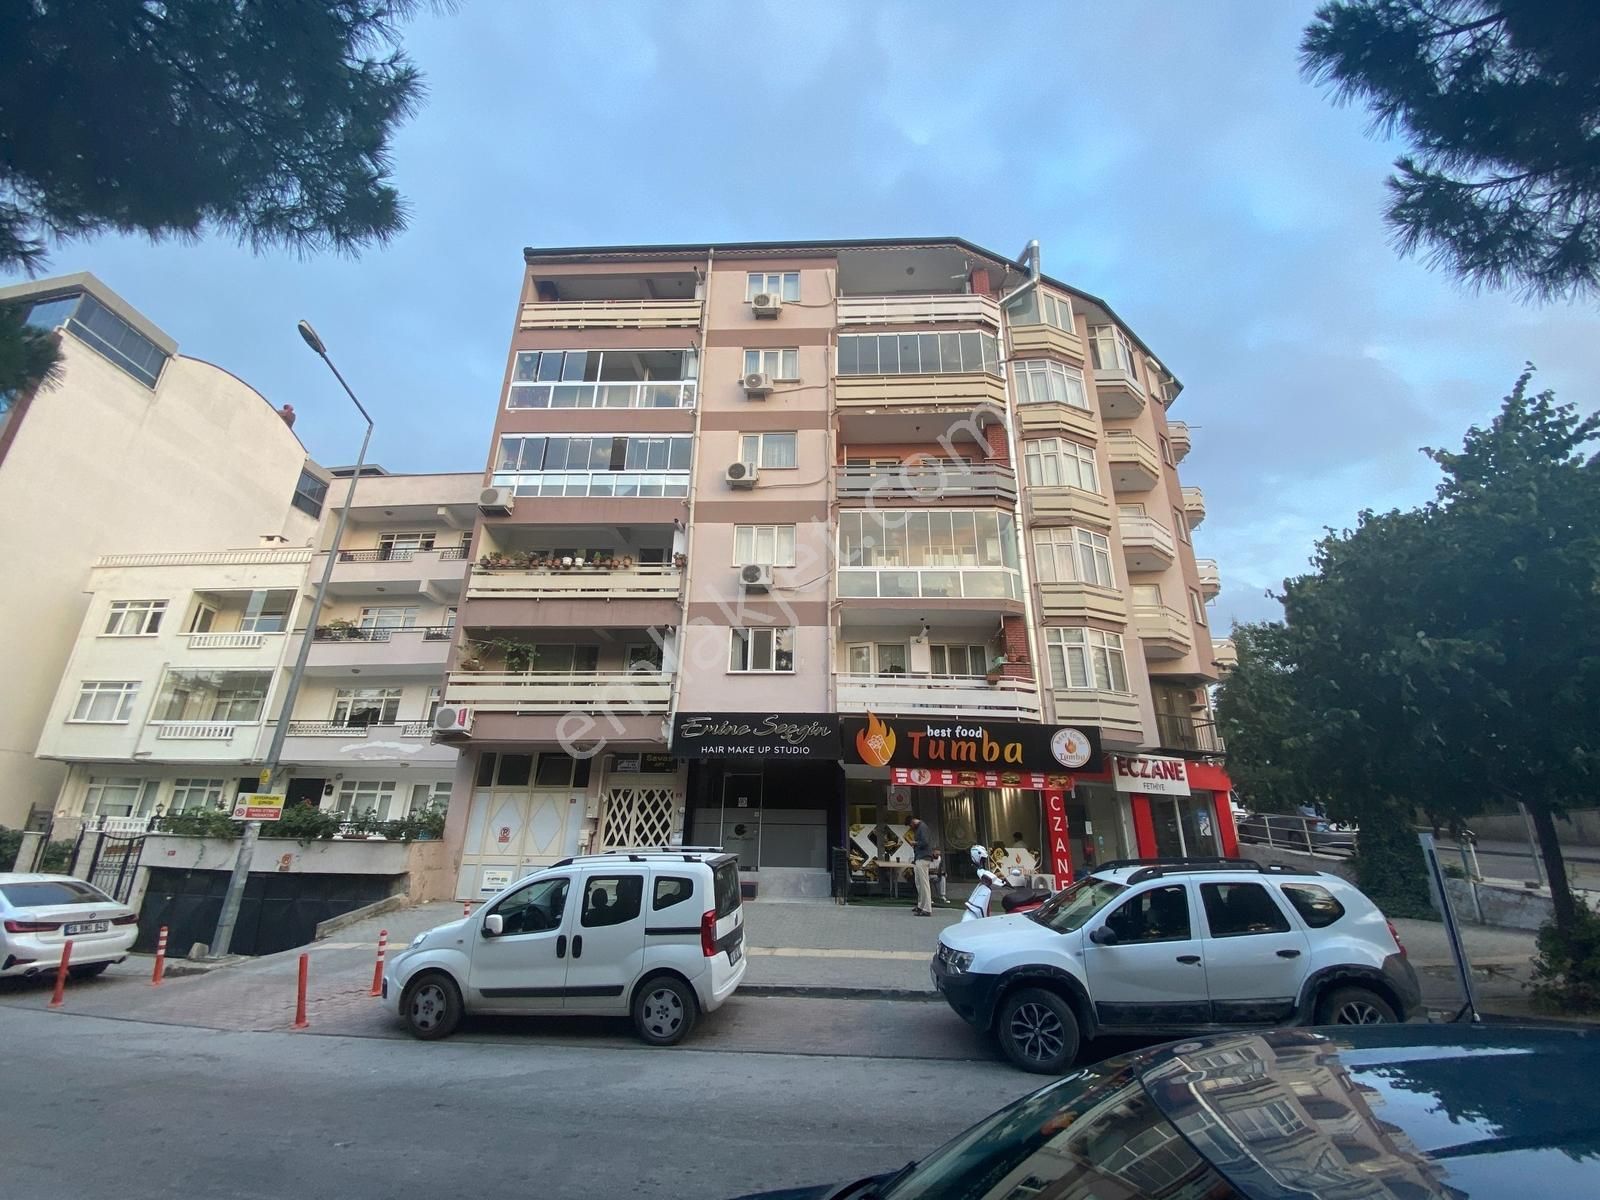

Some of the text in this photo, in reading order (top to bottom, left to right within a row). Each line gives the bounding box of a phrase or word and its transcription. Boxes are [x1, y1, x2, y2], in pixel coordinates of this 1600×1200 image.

[680, 716, 751, 738] Emine
[926, 725, 984, 739] best food
[700, 746, 810, 754] HAIR MAKE UP STUDIO
[907, 730, 1023, 764] Tumba
[1116, 757, 1185, 781] ECZANE
